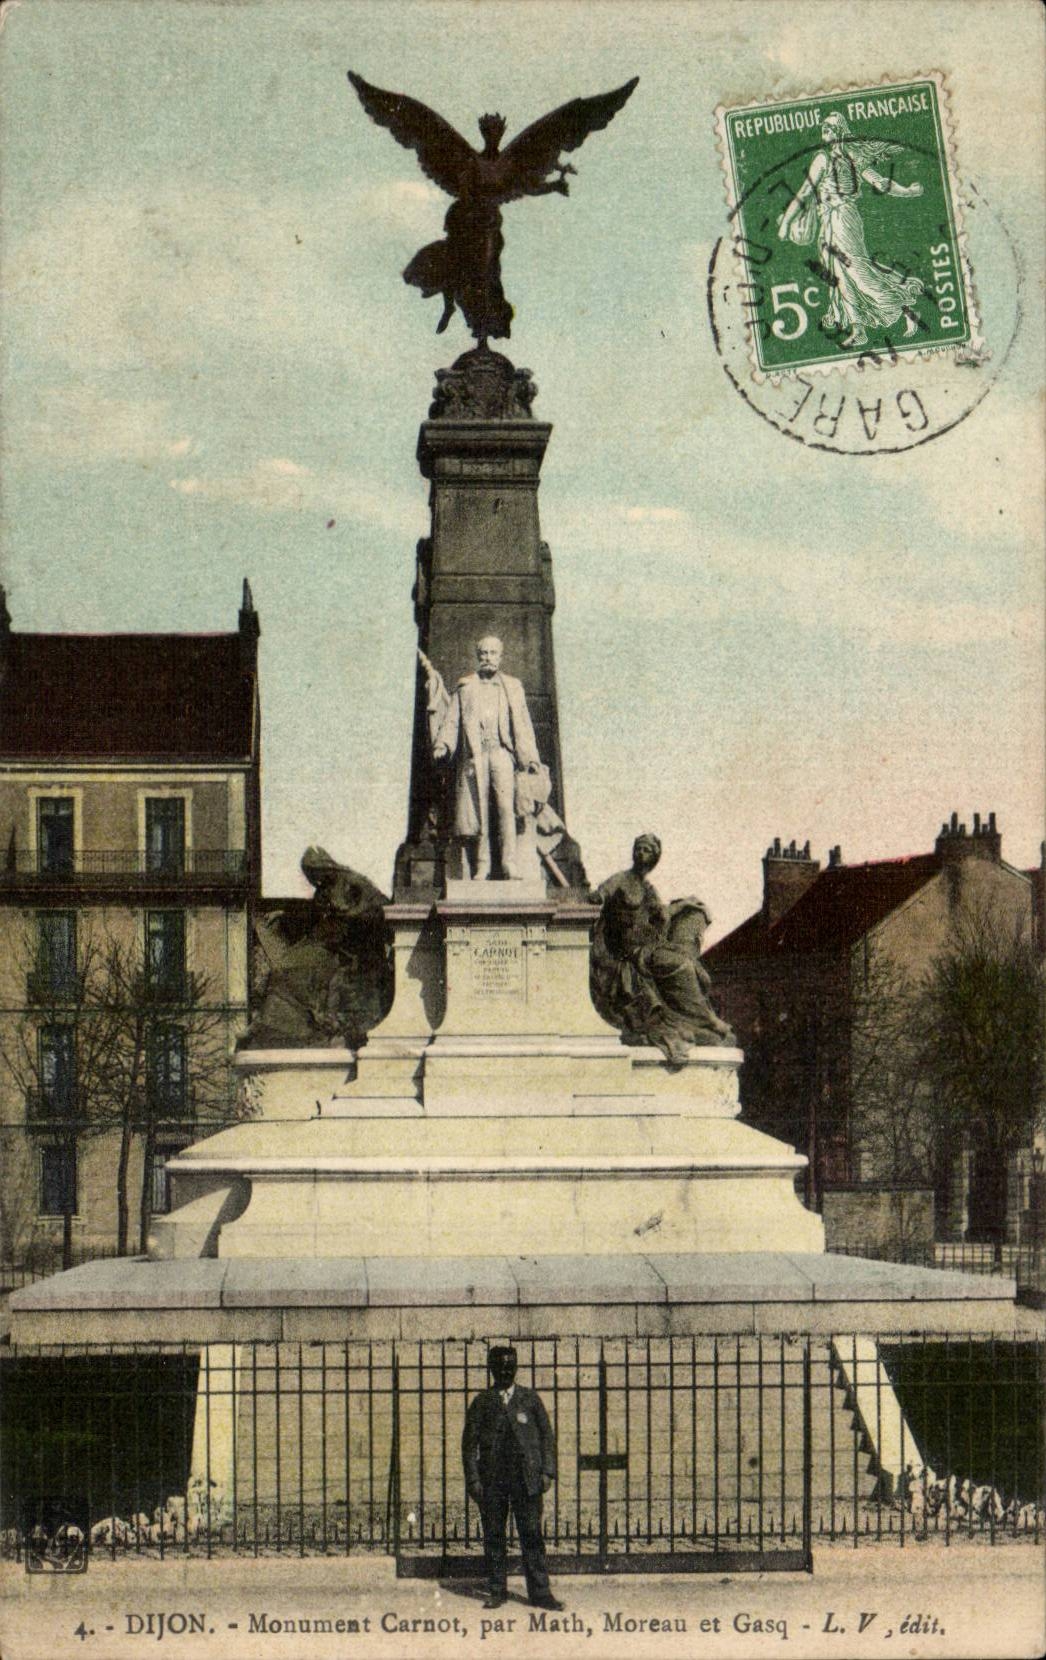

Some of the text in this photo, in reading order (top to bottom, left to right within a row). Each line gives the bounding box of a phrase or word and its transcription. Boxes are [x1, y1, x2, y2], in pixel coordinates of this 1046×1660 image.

[847, 93, 930, 122] FRANÇAISE
[931, 242, 960, 330] POSTES
[774, 374, 929, 441] GARE
